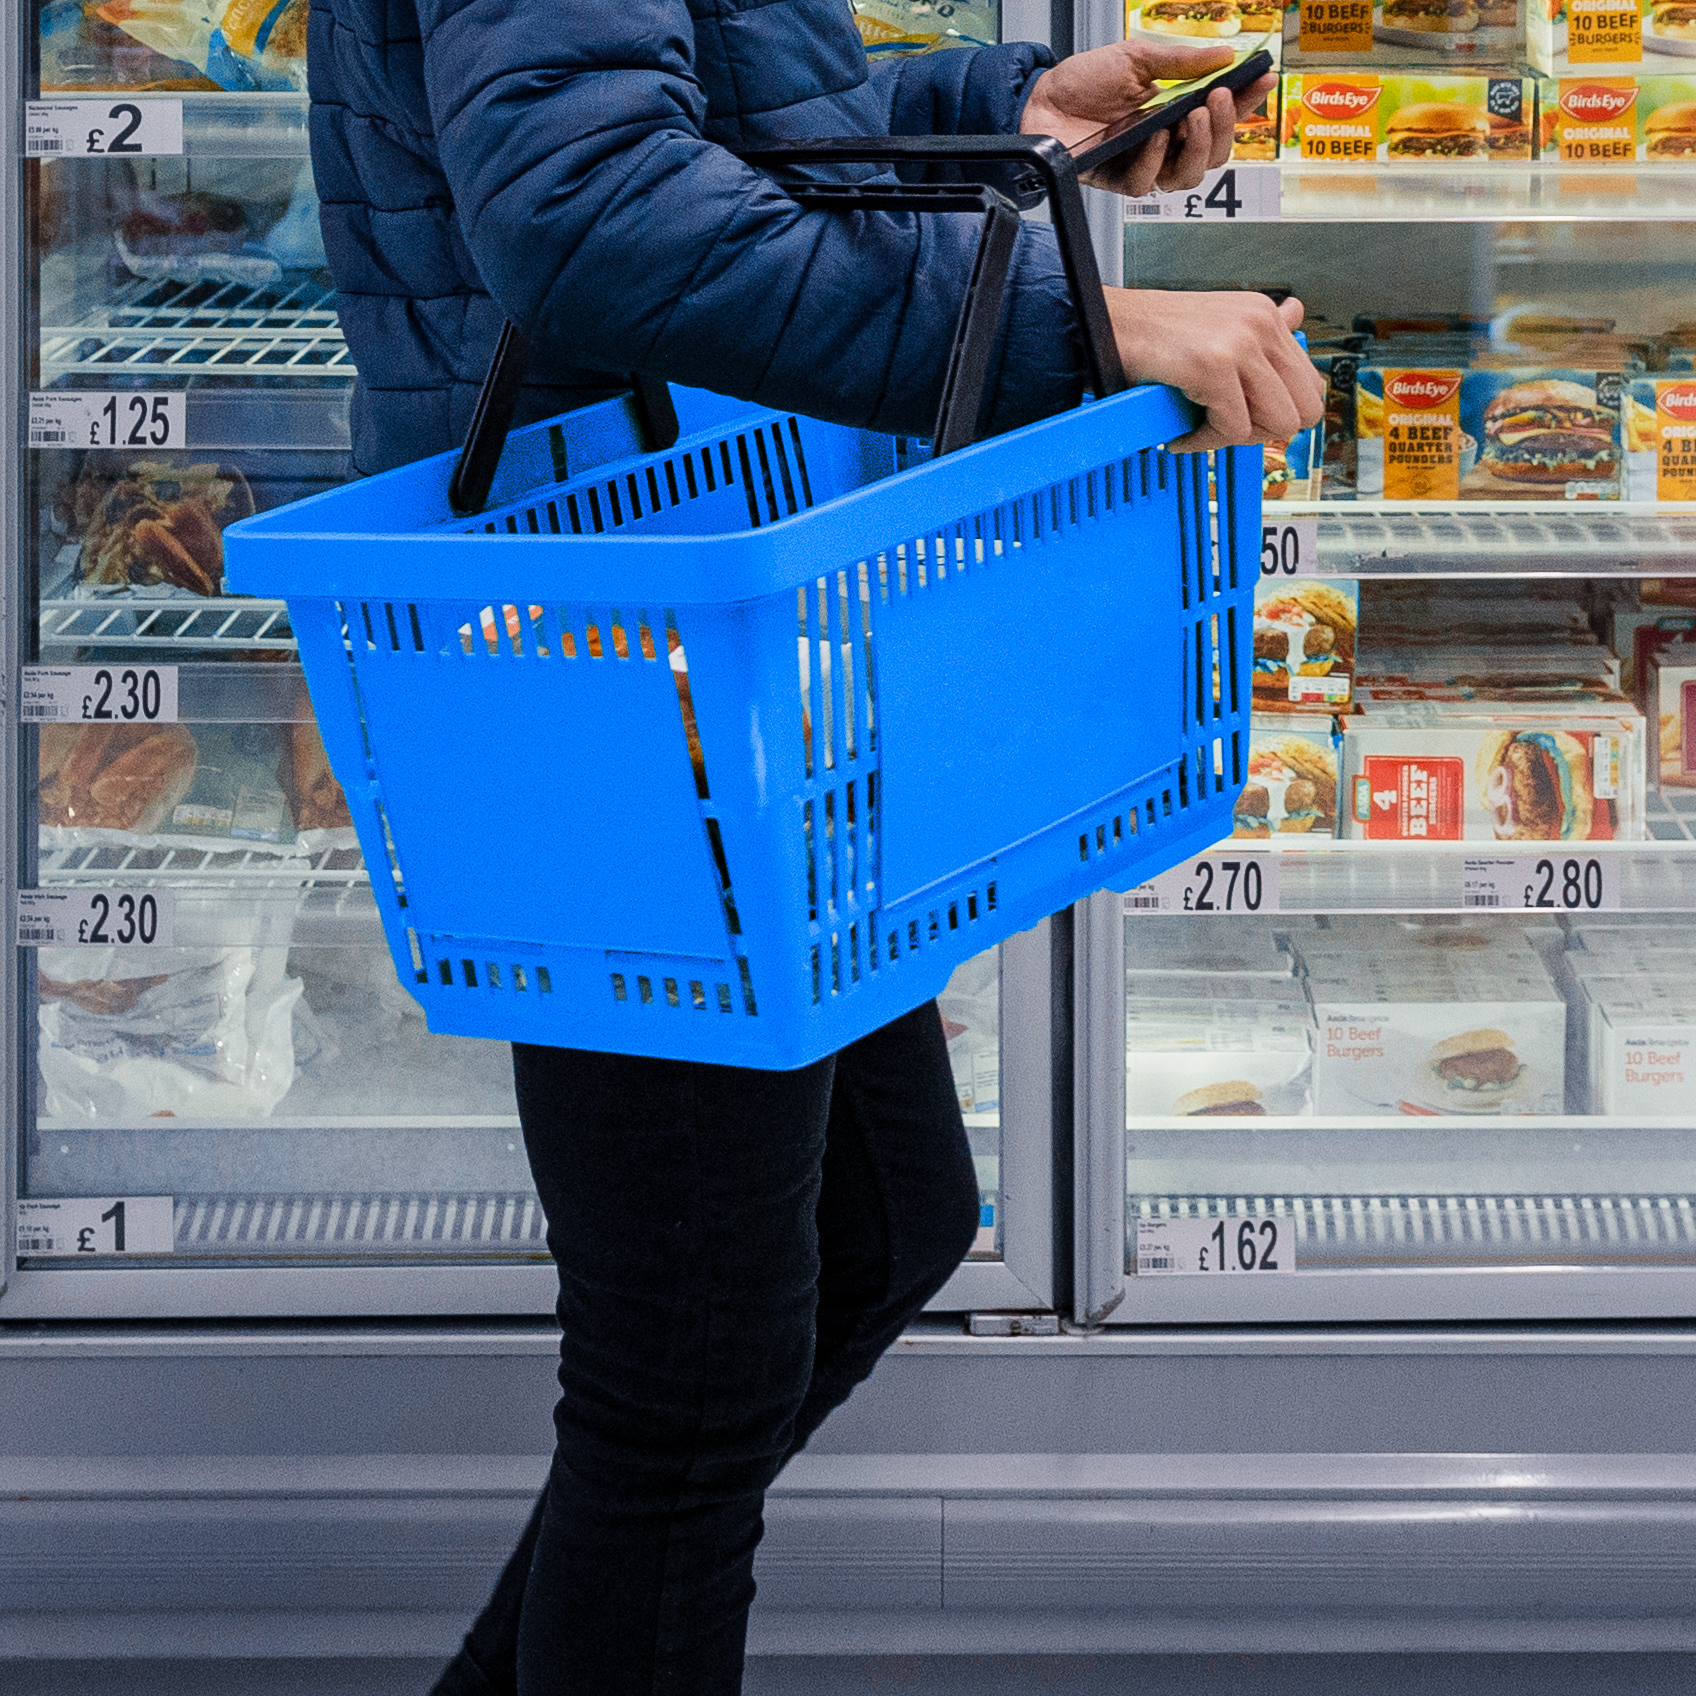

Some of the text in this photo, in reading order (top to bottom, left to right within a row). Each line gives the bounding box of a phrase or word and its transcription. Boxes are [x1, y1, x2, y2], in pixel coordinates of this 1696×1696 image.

[1304, 4, 1371, 21] 10 BEEF
[1573, 12, 1639, 31] 10 BEEF
[1307, 21, 1367, 35] BURGERS
[1575, 30, 1633, 45] BURGERS
[86, 103, 143, 154] £2
[1304, 123, 1373, 138] ORIGINAL
[1563, 126, 1632, 141] ORIGINAL
[1307, 139, 1374, 157] 10 BEEF
[1564, 141, 1633, 160] 10 BEEF
[1184, 169, 1243, 219] £4
[89, 395, 170, 446] £1.25
[1388, 413, 1454, 427] ORIGINAL
[1388, 426, 1454, 440] 4 BEEF
[1388, 441, 1454, 453] QUARTER
[1662, 439, 1674, 453] 4
[1388, 453, 1454, 465] POUNDERS
[82, 669, 161, 720] £2.30
[1357, 781, 1371, 820] ASDA
[1373, 790, 1398, 812] 4
[1410, 764, 1429, 838] BEEF
[1183, 860, 1263, 911] £2.70
[1524, 858, 1603, 909] £2.80
[78, 893, 158, 945] £2.30
[1326, 1025, 1383, 1042] 10 Beef
[1326, 1042, 1385, 1062] Burgers
[1624, 1049, 1682, 1067] 10 Beef
[1624, 1068, 1685, 1085] Burgers
[77, 1201, 126, 1252] £1
[1198, 1220, 1280, 1272] £1.62
